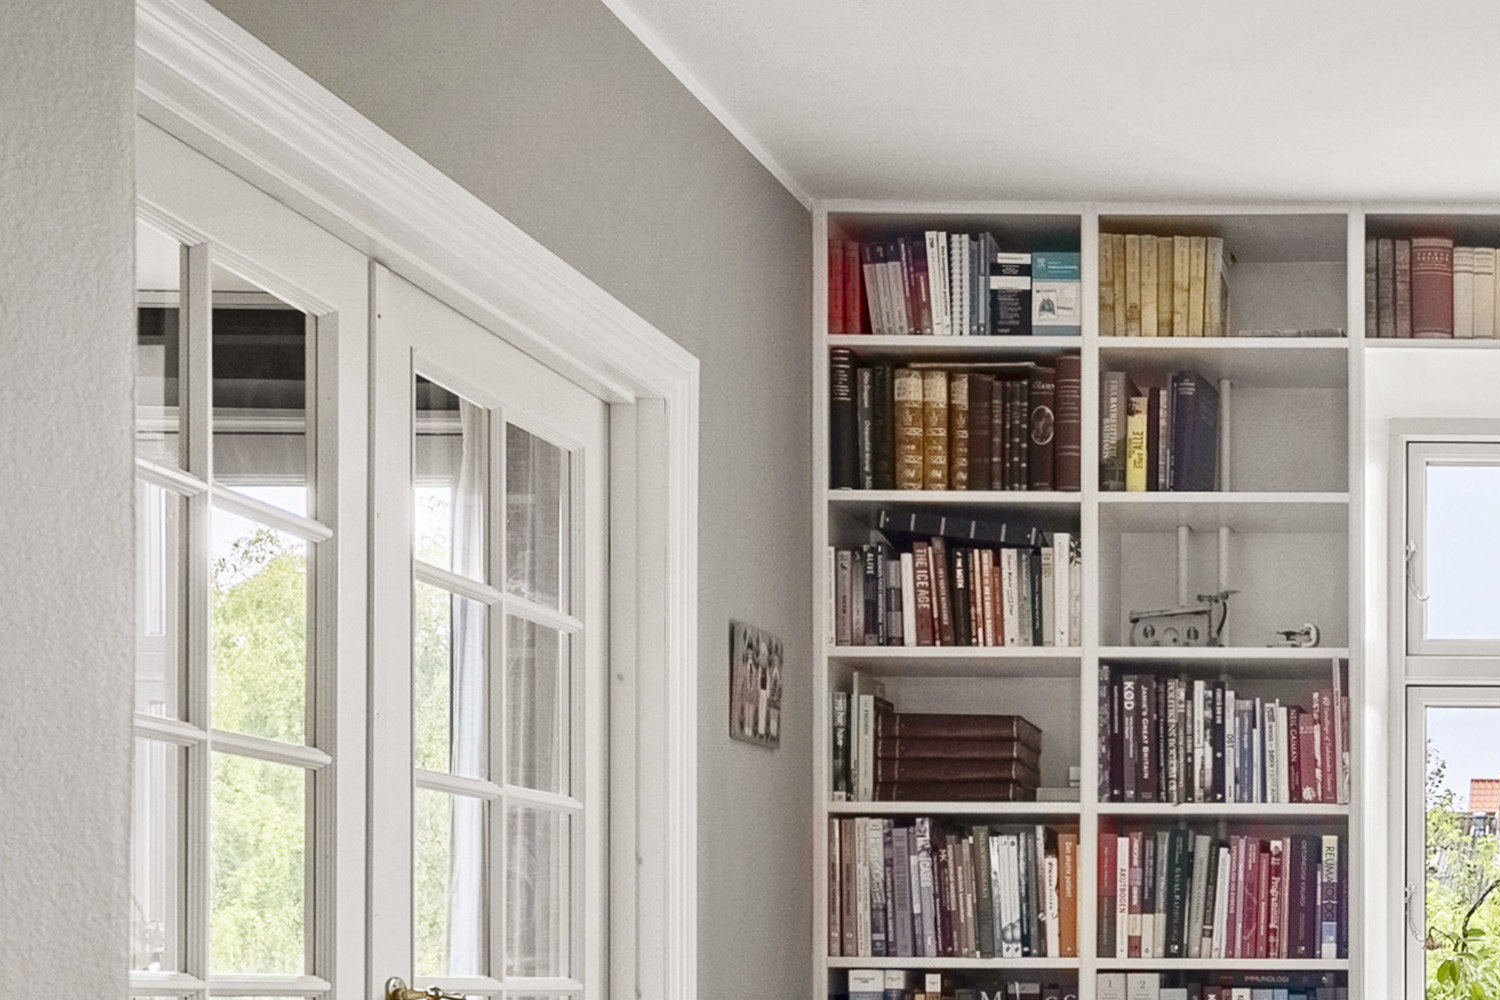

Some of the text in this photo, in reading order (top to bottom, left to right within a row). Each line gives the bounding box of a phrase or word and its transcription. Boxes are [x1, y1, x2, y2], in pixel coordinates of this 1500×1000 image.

[866, 553, 874, 575] ALIVE
[916, 549, 930, 611] THE ICE AGE
[1124, 681, 1135, 711] KØD
[1141, 685, 1150, 780] JAMIE'S GREAT BRITAIN
[1289, 709, 1298, 763] NEIL GAIMAN
[1064, 841, 1073, 898] Den akutte patient
[1118, 867, 1127, 914] AKUTBOGEN
